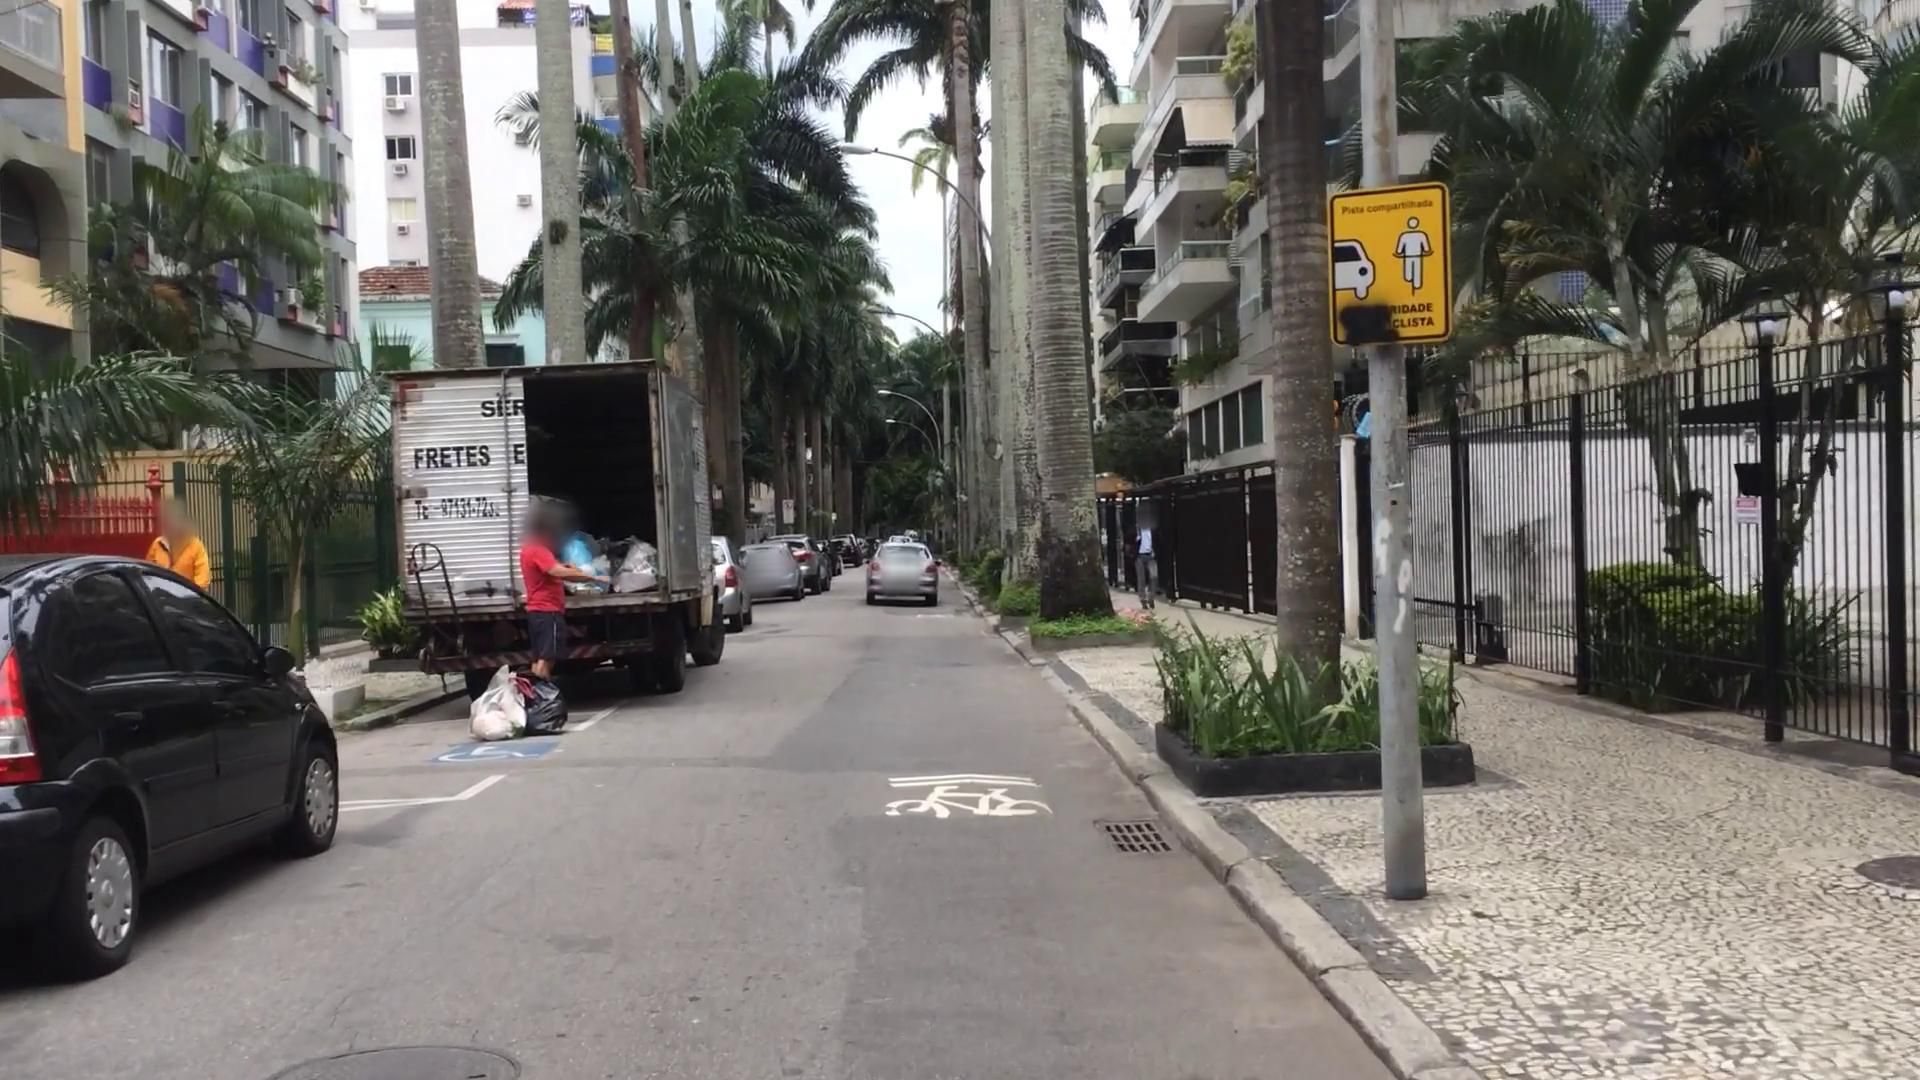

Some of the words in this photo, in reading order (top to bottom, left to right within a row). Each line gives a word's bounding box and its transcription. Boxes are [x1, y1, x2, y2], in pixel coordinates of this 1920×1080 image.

[1342, 206, 1364, 215] Pista
[1366, 199, 1433, 213] compartilhada
[1390, 303, 1433, 314] RIDADE
[1392, 317, 1434, 328] CLISTA
[413, 445, 491, 469] FRETES
[513, 443, 525, 465] E
